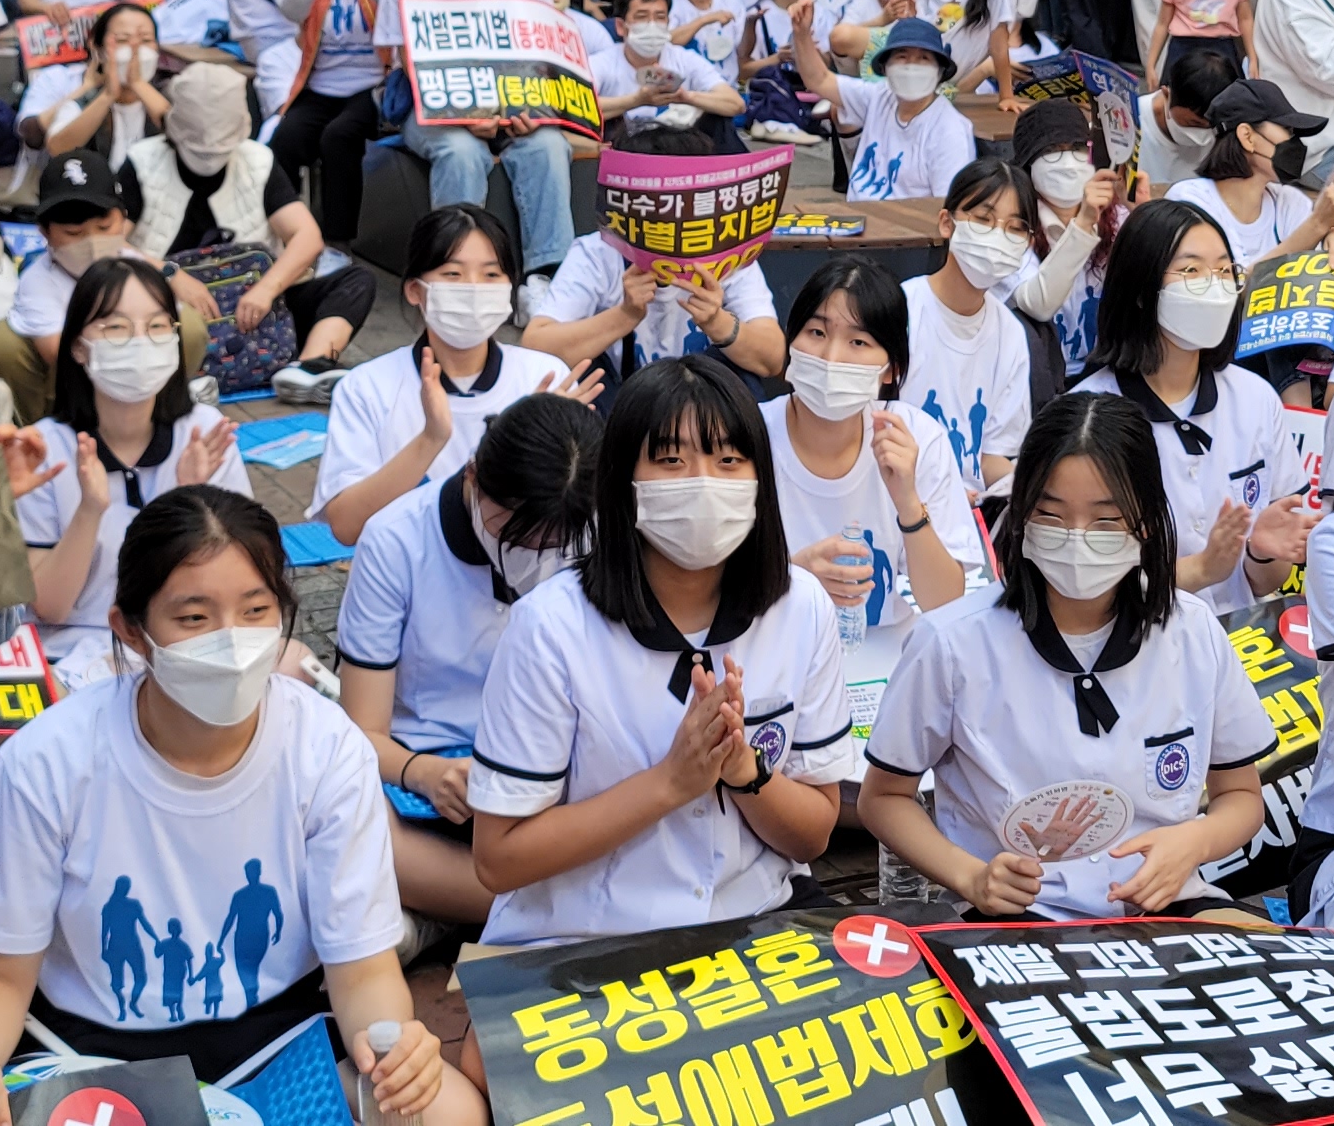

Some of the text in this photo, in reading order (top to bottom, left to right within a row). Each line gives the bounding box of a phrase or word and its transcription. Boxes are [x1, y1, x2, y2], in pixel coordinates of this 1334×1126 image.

[606, 170, 782, 219] 다수가 불평등한
[605, 197, 778, 254] 차별금지법
[1163, 758, 1185, 776] DICS
[952, 940, 1071, 991] 제발
[1057, 937, 1170, 980] 그만
[1153, 931, 1266, 974] 그만
[512, 928, 842, 1084] 동성결혼
[1063, 1051, 1246, 1126] 너무
